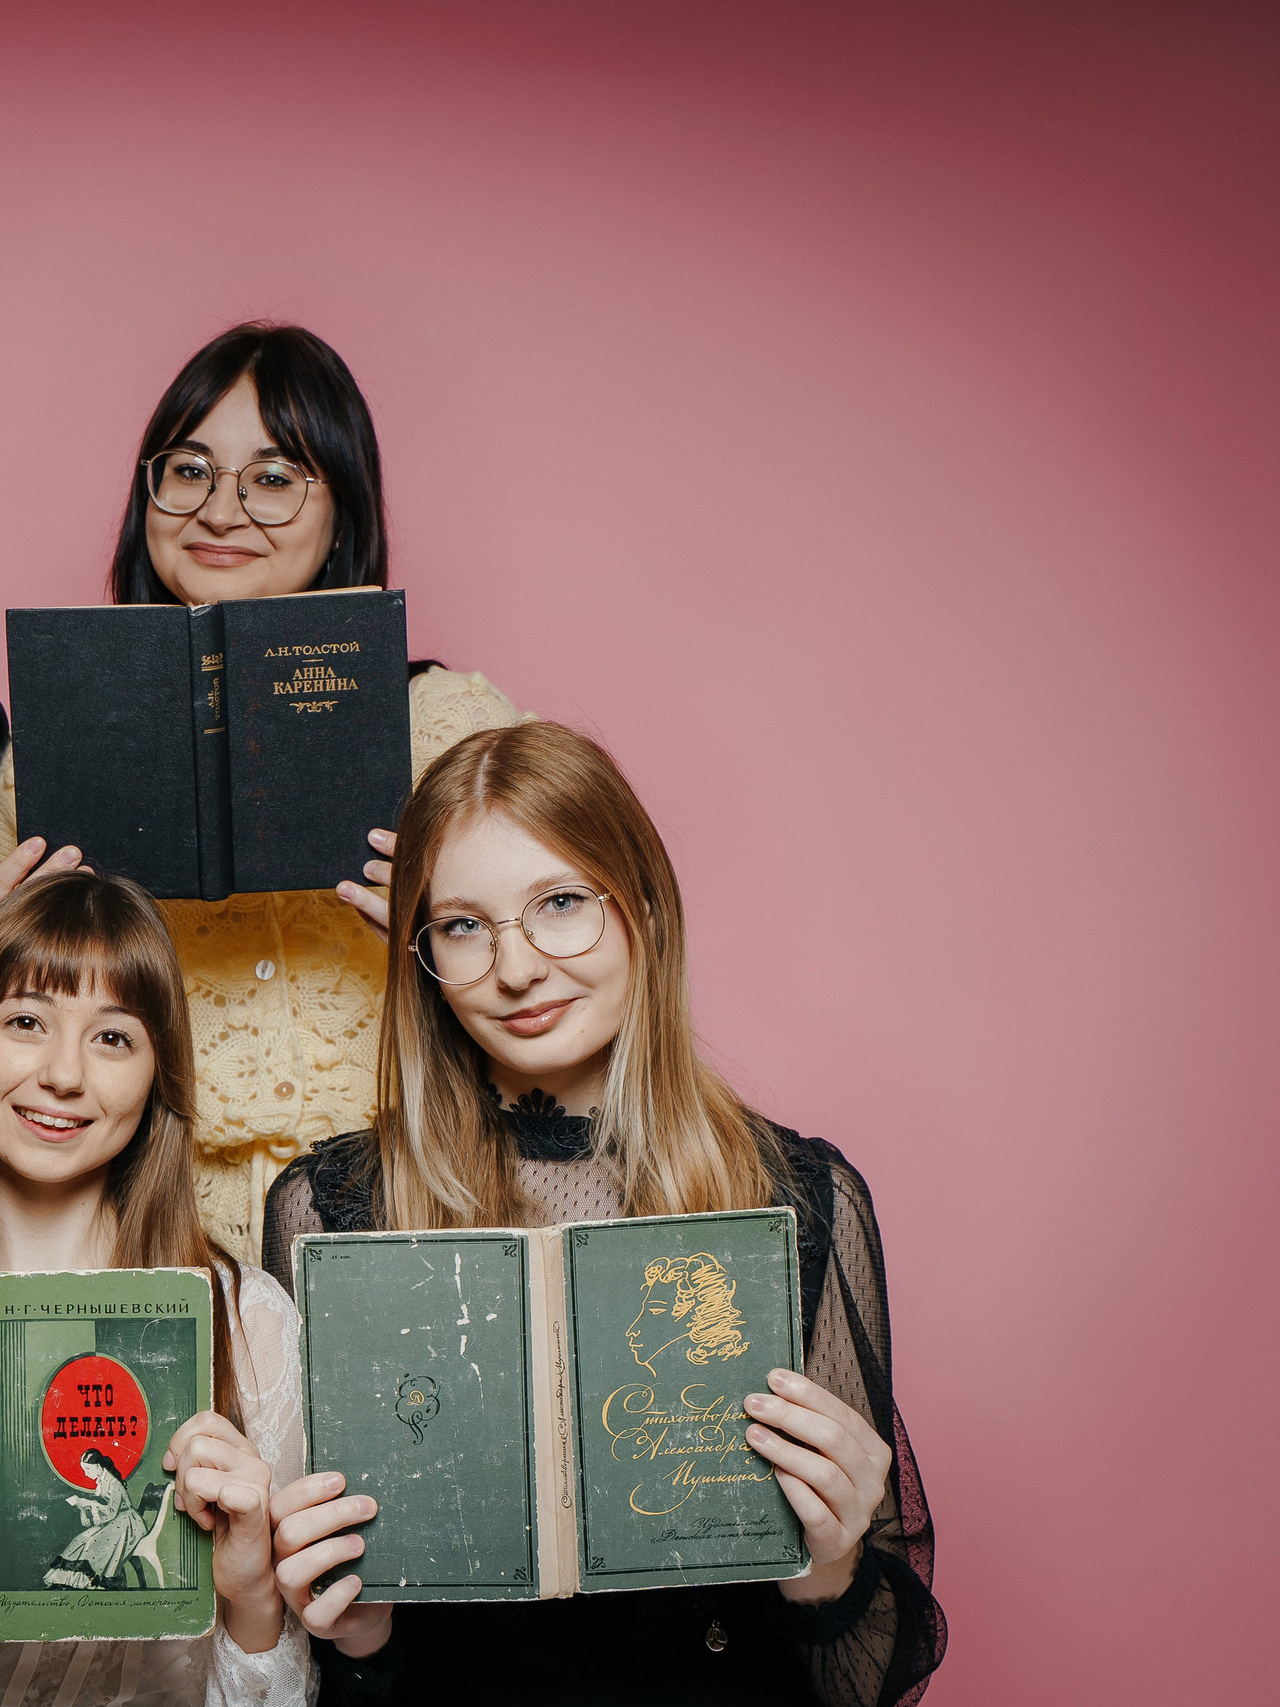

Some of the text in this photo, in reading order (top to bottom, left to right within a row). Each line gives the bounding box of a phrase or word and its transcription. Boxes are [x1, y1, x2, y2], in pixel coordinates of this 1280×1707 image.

[292, 666, 337, 680] АННА
[273, 678, 359, 695] КАРЕНИНА
[77, 1383, 114, 1407] ЧТО
[602, 1383, 754, 1439] Стихотворен
[53, 1415, 138, 1439] ДЕЛАТЬ?
[612, 1426, 753, 1463] Александра
